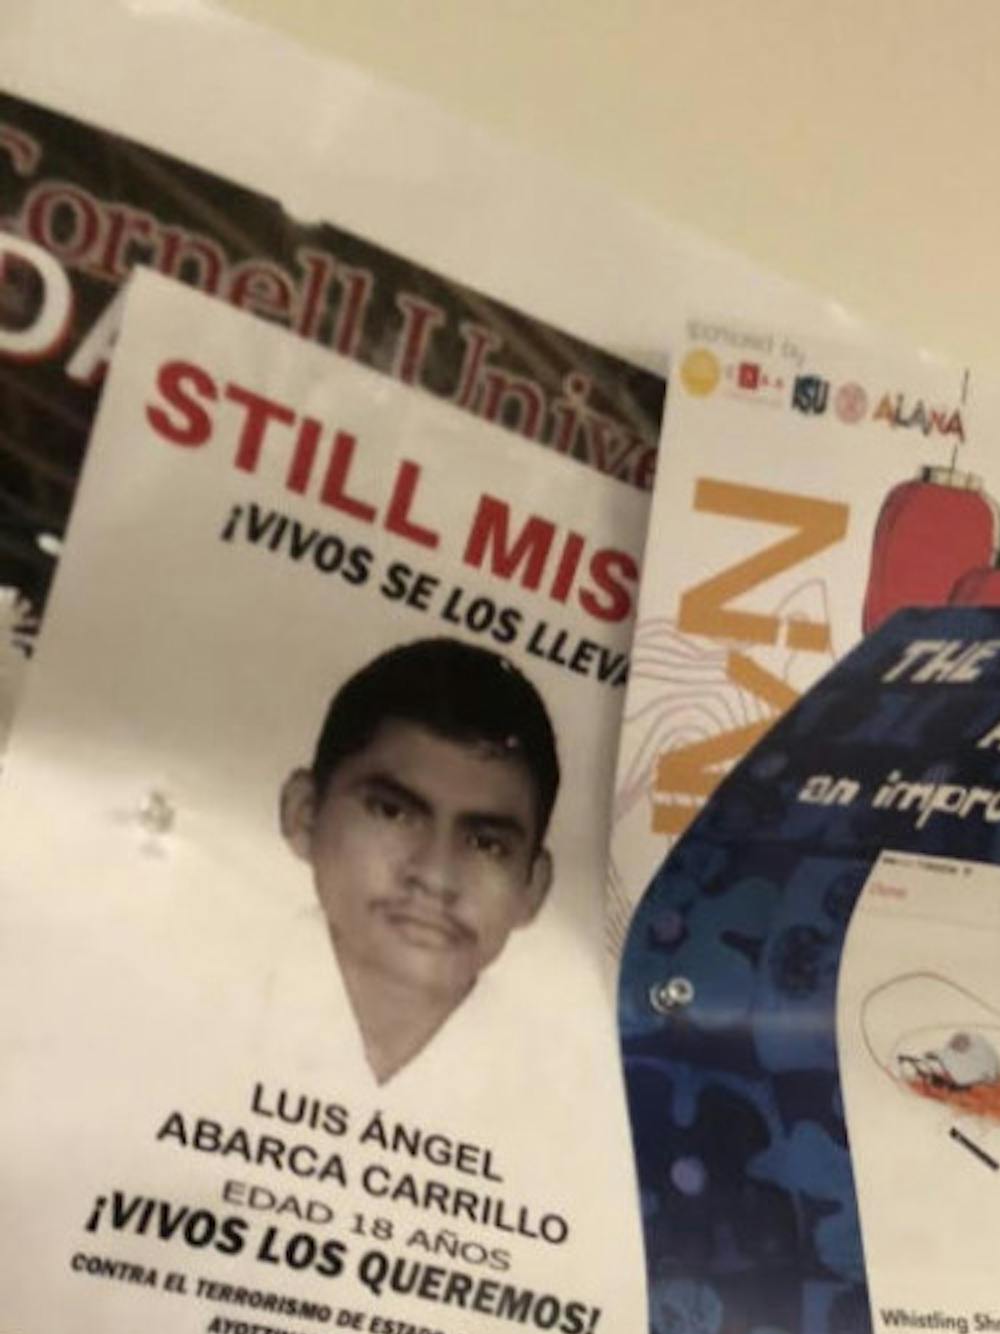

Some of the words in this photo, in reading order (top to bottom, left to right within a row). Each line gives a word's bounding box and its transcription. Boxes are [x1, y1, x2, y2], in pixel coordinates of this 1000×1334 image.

[145, 359, 440, 549] STILL
[872, 393, 965, 444] ALANA
[220, 503, 375, 586] ¡VIVOS
[380, 563, 433, 611] SE
[440, 587, 521, 645] LOS
[797, 774, 860, 807] an
[155, 1110, 350, 1190] ABARCA
[359, 1163, 571, 1249] CARRILLO
[249, 1081, 350, 1138] LUIS
[358, 1110, 507, 1185] ÁNGEL
[84, 1188, 250, 1258] ¡VIVOS
[253, 1224, 349, 1281] LOS
[219, 1177, 337, 1227] EDAD
[349, 1210, 395, 1244] 18
[403, 1223, 515, 1274] AÑOS
[69, 1251, 159, 1290] CONTRA
[162, 1271, 190, 1297] EL
[194, 1277, 334, 1327] TERRORISMO
[335, 1306, 366, 1334] DE
